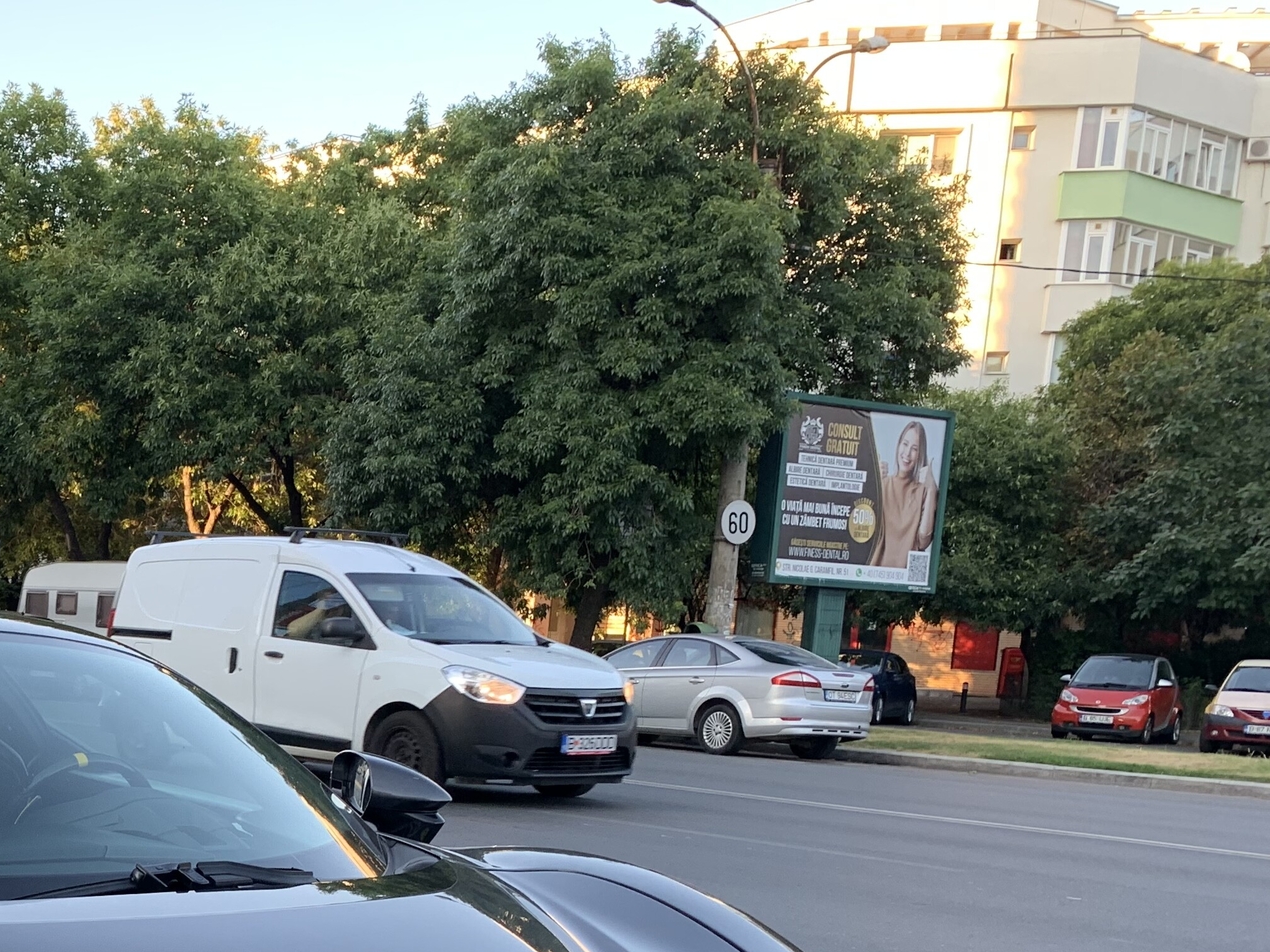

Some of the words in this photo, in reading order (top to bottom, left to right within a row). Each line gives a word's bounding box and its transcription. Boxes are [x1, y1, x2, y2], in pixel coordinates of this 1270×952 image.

[828, 422, 863, 440] CONSULT
[826, 438, 860, 456] GRATUIT
[836, 458, 854, 466] PREMIUM
[781, 500, 786, 511] O
[786, 499, 803, 514] VIAȚĂ
[803, 502, 814, 514] MAI
[815, 502, 830, 515] BUNĂ
[831, 502, 851, 517] ÎNCEPE
[853, 508, 874, 525] 50%
[729, 512, 748, 534] 60
[782, 514, 790, 525] CU
[791, 514, 799, 526] UN
[799, 514, 822, 528] ZÂMBET
[792, 564, 809, 573] NICOLAE
